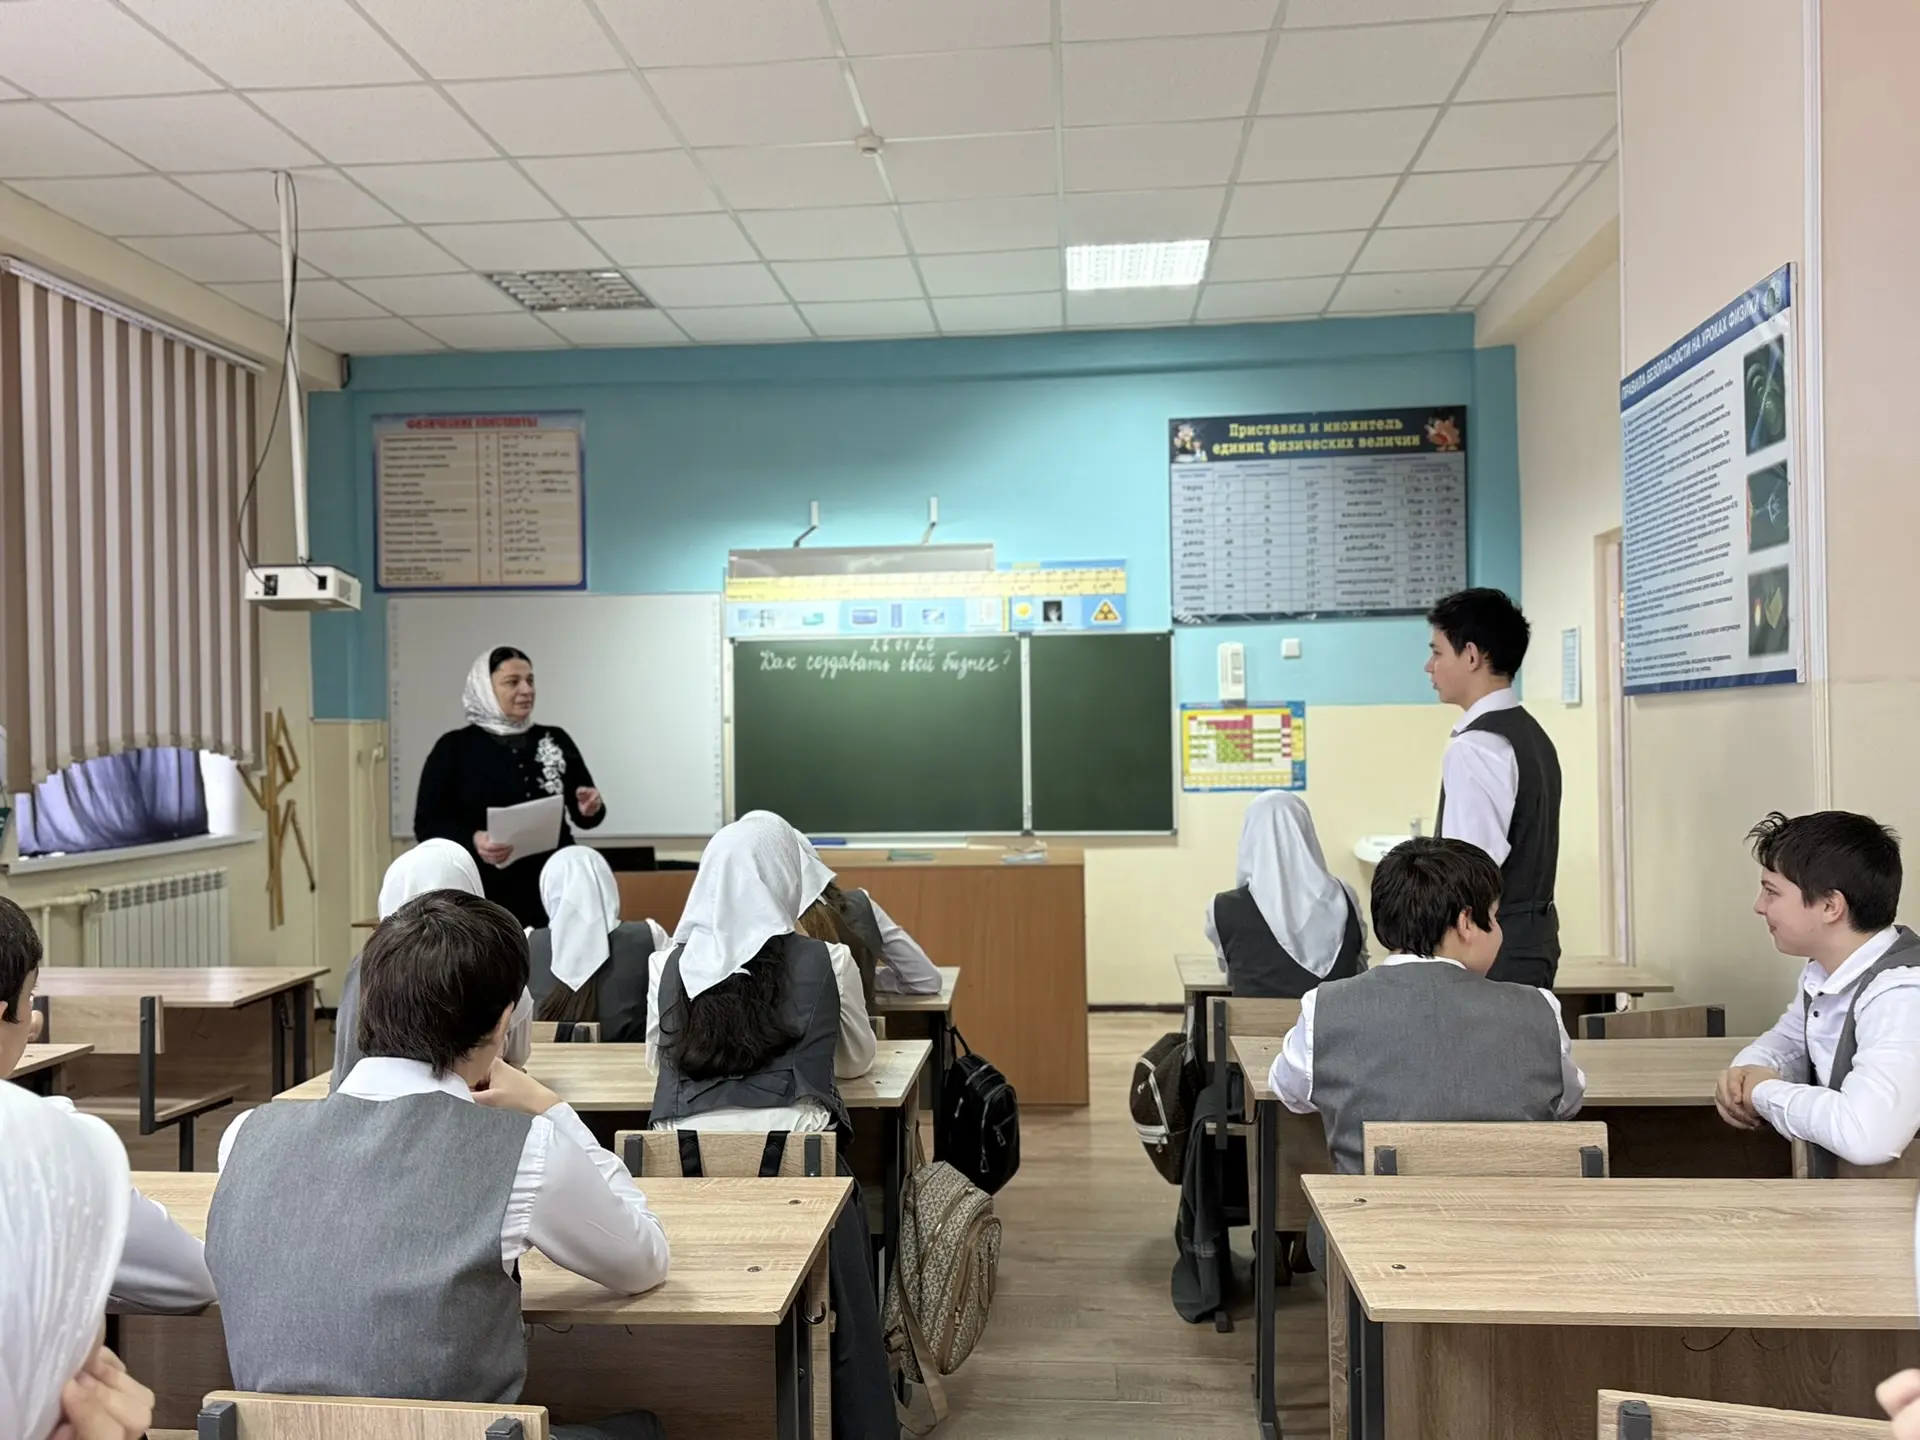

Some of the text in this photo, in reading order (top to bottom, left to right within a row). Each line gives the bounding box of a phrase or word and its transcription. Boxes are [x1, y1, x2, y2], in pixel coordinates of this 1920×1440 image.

[1645, 342, 1691, 383] БЕЗОПАСНОСТИ
[1690, 336, 1702, 357] НА
[1701, 318, 1728, 348] УРОКАХ
[1728, 294, 1760, 330] ФИЗИКИ
[1228, 418, 1403, 439] Приставка и множитель
[1212, 434, 1421, 456] единиц физических величин
[759, 649, 797, 672] Как
[805, 649, 892, 680] создавать
